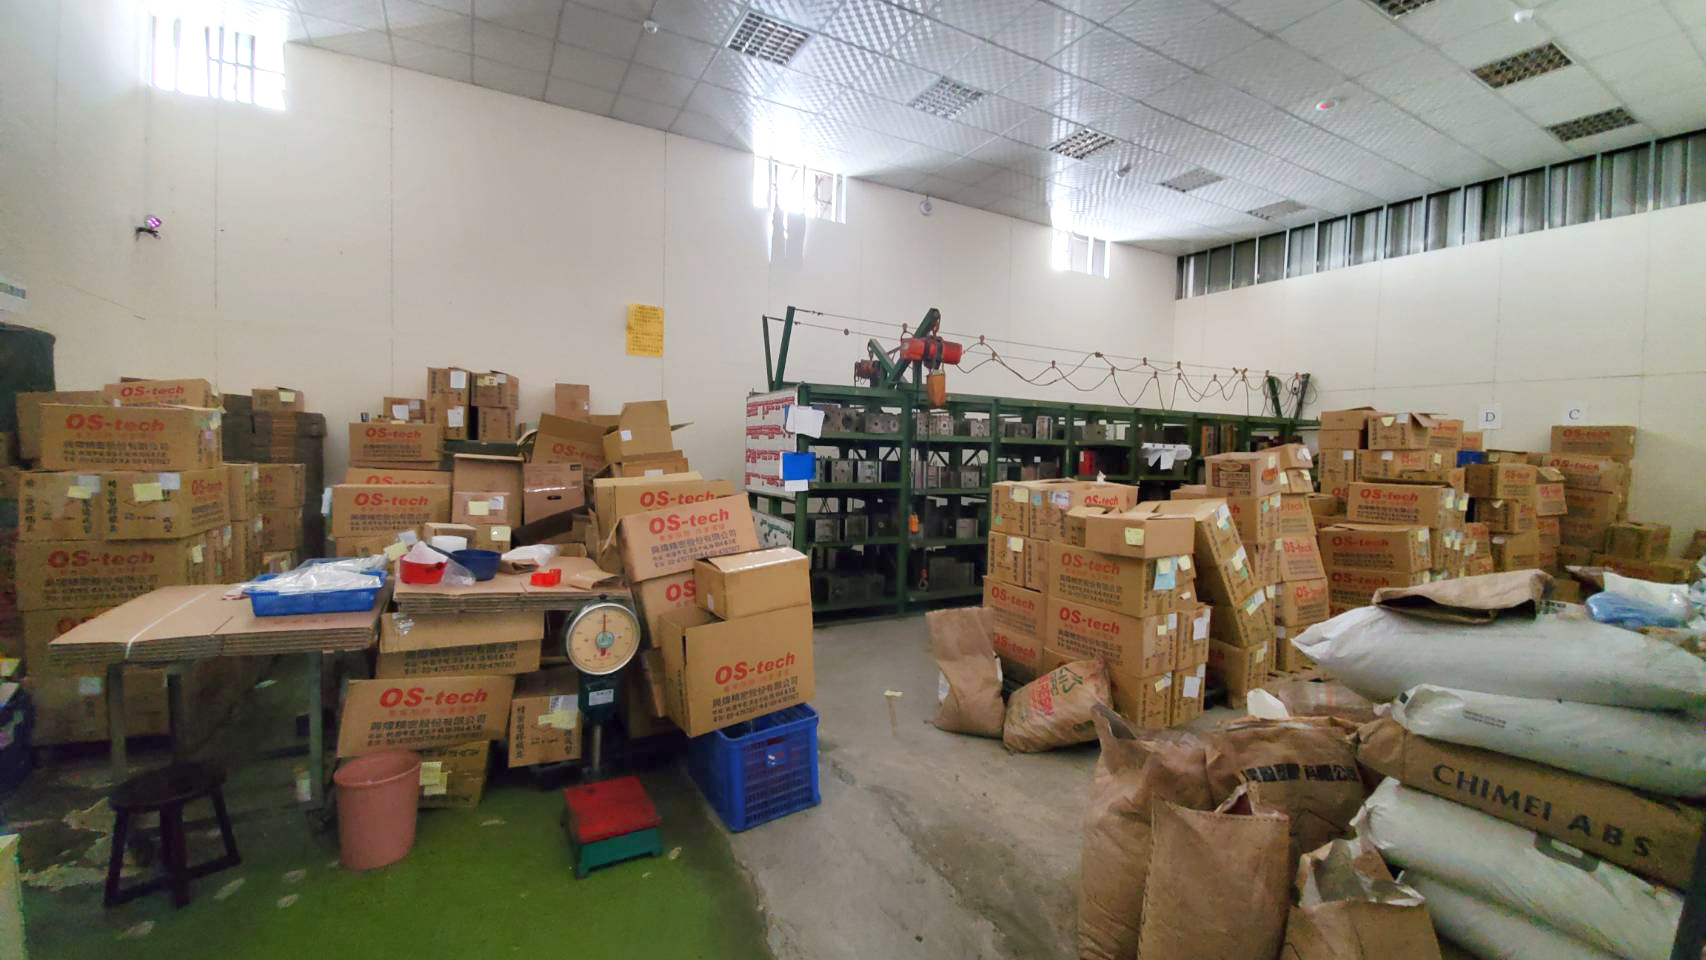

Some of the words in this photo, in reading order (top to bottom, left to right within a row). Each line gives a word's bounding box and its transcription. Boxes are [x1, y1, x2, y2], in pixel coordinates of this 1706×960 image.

[121, 385, 184, 397] OS-tech
[65, 413, 166, 432] OS-tech
[1485, 411, 1496, 422] D
[1568, 409, 1580, 420] C
[366, 427, 421, 439] OS-tech
[354, 492, 430, 506] OS-tech
[640, 490, 714, 508] OS-tech
[1084, 495, 1119, 506] OS-tech
[1360, 489, 1418, 501] OS-tech
[649, 509, 729, 535] OS-tech
[48, 550, 154, 568] OS-tech
[1061, 553, 1120, 575] OS-tech
[991, 586, 1035, 611] OS-tech
[1059, 607, 1120, 635] OS-tech
[715, 652, 796, 685] OS-tech
[379, 687, 488, 708] OS-tech
[1432, 763, 1552, 821] CHIMEI
[1567, 814, 1652, 857] ABS
